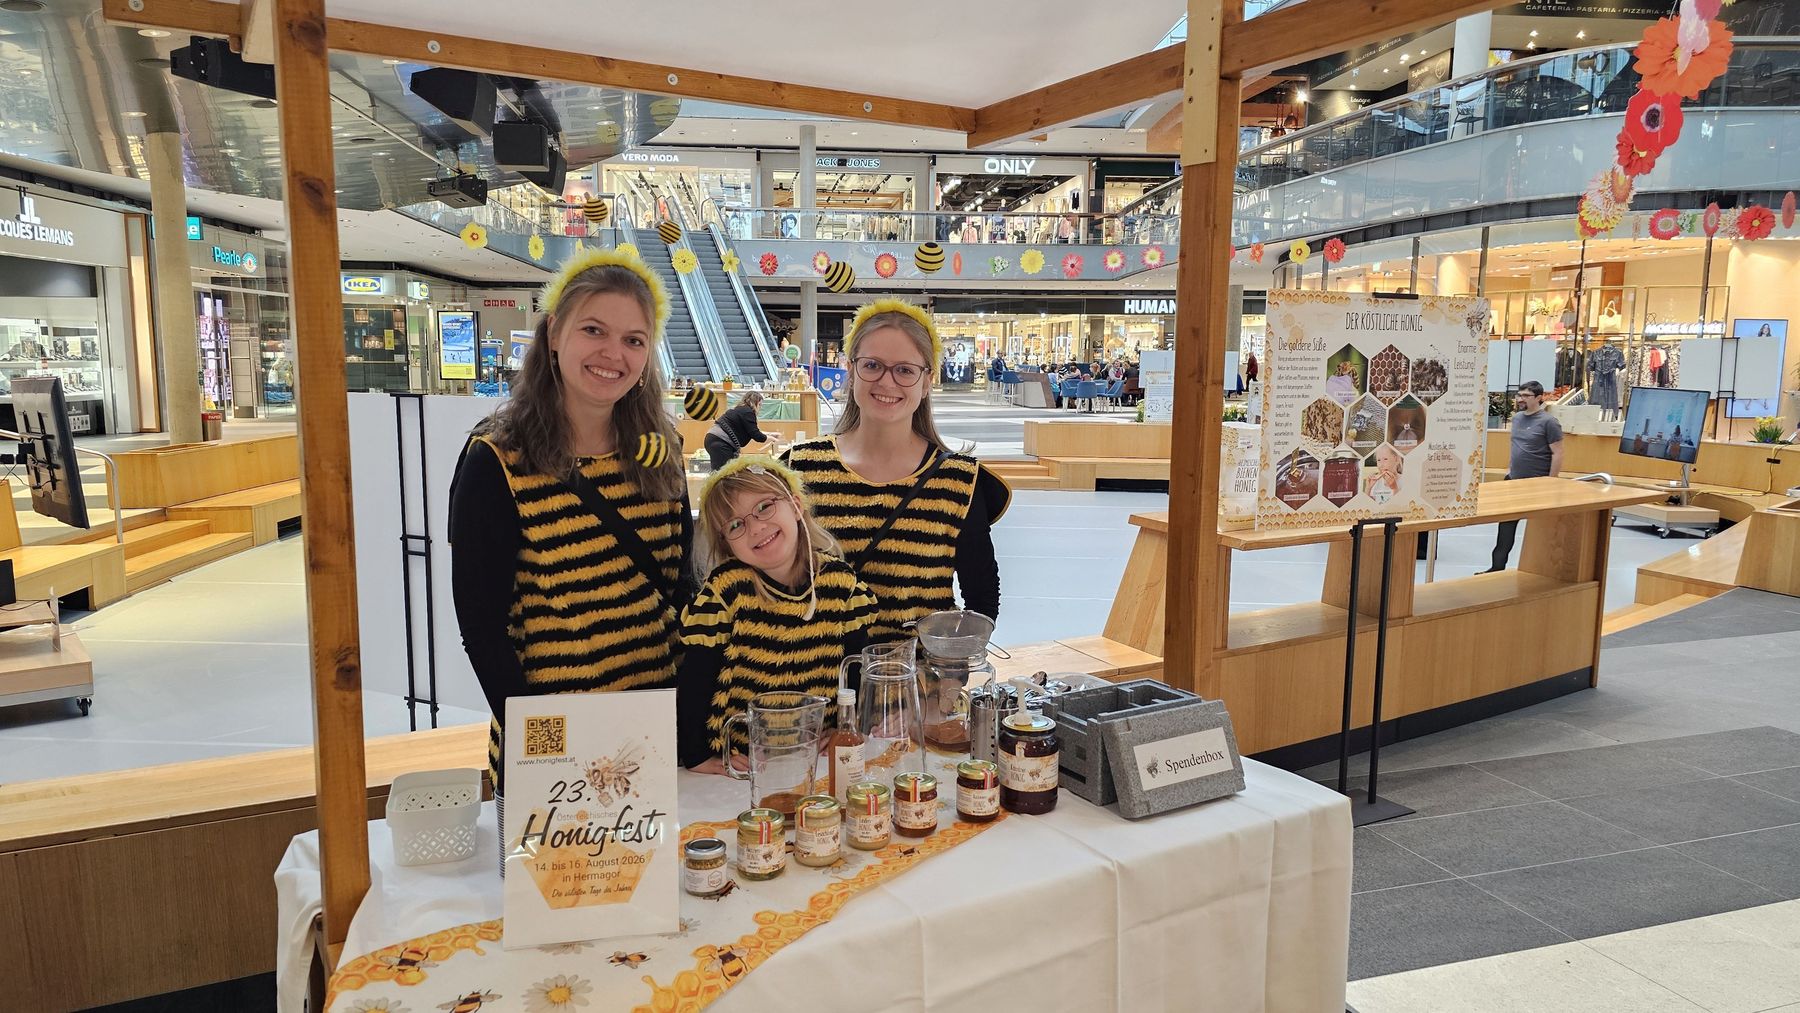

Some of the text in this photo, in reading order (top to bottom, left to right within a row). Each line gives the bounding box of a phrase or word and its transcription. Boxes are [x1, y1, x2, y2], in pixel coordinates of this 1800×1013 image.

[622, 153, 680, 162] VERO MODA
[815, 156, 880, 168] ACK JONES
[985, 157, 1036, 175] ONLY
[0, 218, 74, 246] CQUES LEMANS
[213, 246, 241, 266] Pearle
[1346, 310, 1423, 332] DER KÖSTLICHE HONIG
[1278, 336, 1288, 351] Die
[1288, 339, 1312, 354] goldene
[1457, 340, 1477, 353] Enorme
[1236, 467, 1258, 479] BIENEN
[1234, 479, 1257, 493] HONIG
[516, 756, 576, 766] www.honigfest.at
[1165, 750, 1225, 774] Spendenbox
[547, 780, 591, 804] 23.
[520, 804, 666, 857] Honigfest
[534, 855, 646, 872] 14. bis 16. August 2026
[562, 870, 622, 883] in Hermagor
